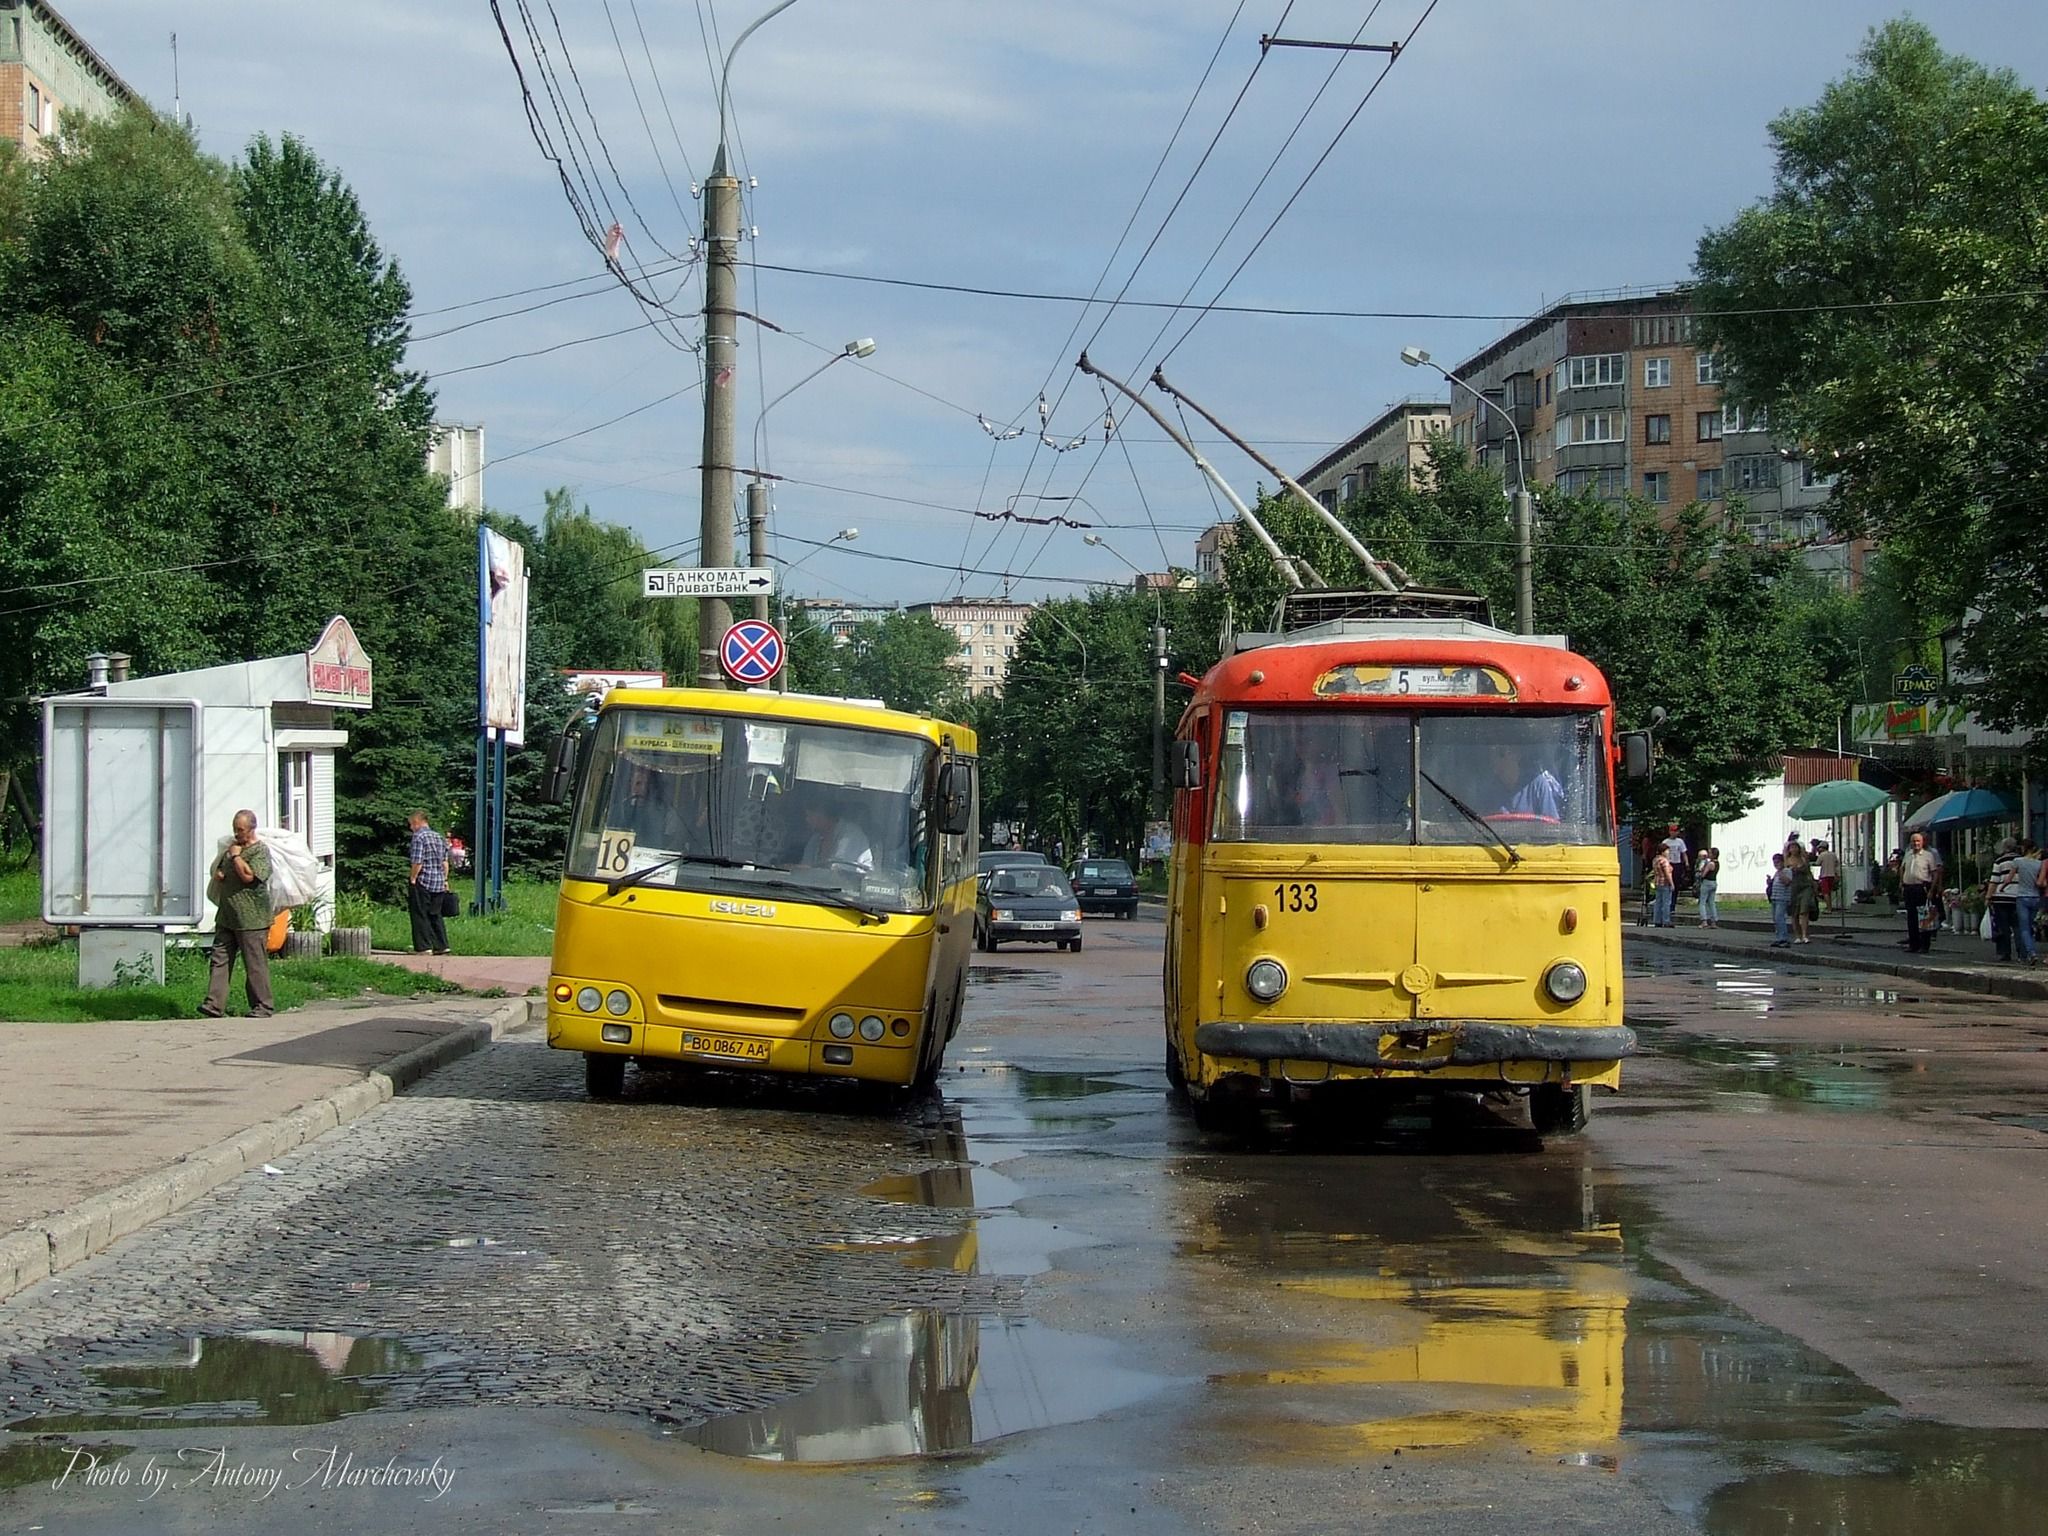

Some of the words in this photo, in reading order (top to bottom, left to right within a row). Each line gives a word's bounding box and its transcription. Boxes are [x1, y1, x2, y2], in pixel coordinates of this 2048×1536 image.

[667, 572, 746, 583] БАНКОМАТ
[667, 582, 749, 595] ПриватБанк
[1399, 670, 1410, 694] 5
[598, 837, 630, 873] 18
[1274, 883, 1318, 913] 133
[709, 899, 776, 917] ISUZU
[692, 1037, 711, 1051] BO
[714, 1040, 743, 1054] 0867
[747, 1043, 764, 1056] AA
